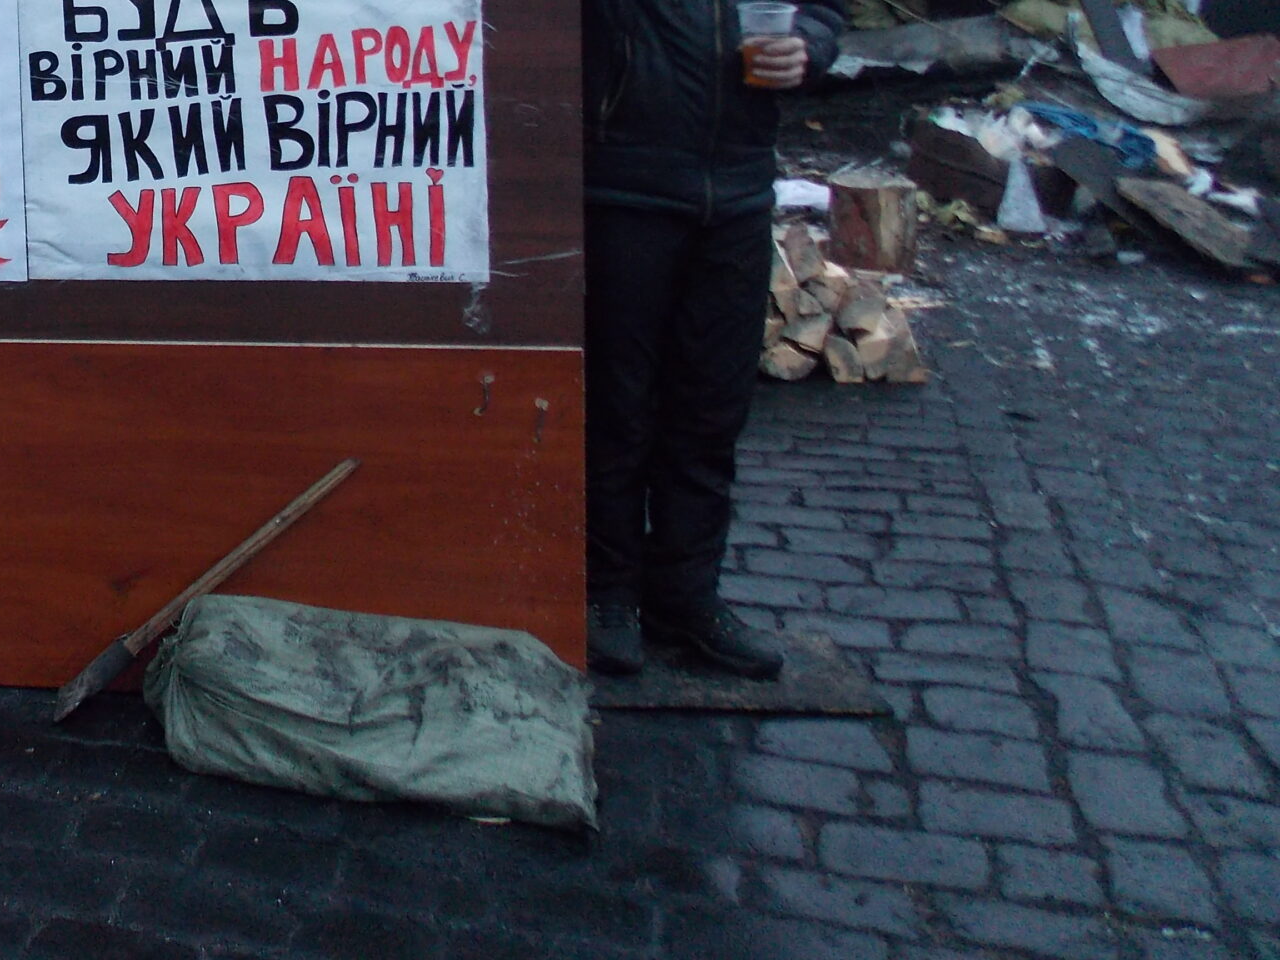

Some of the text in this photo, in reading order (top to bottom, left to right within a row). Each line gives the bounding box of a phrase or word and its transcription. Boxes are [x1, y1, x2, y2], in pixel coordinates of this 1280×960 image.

[258, 20, 478, 92] НАРОДУ,
[60, 94, 247, 185] ЯКИЙ
[107, 167, 447, 268] УКРАЇНІ
